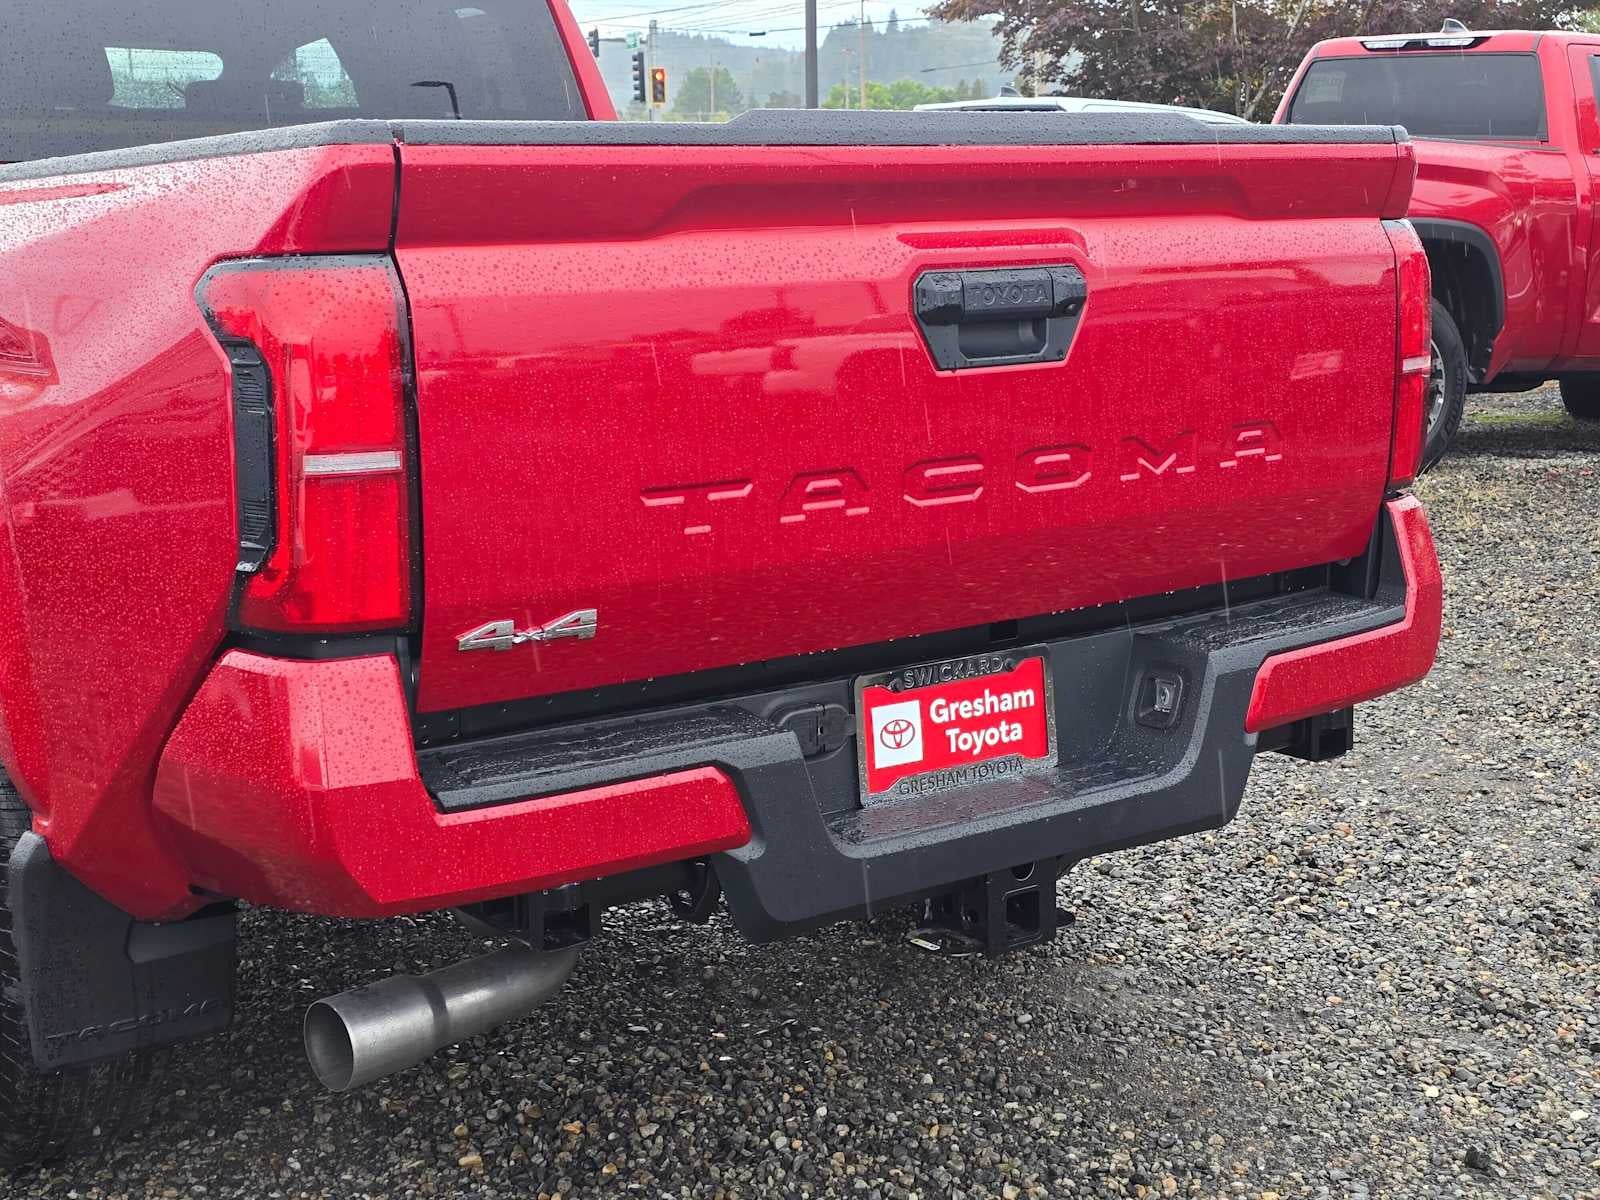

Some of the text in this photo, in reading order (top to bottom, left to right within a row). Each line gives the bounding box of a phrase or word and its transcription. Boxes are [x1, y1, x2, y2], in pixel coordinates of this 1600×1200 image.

[967, 284, 1049, 307] TOYOTA
[640, 420, 1283, 535] TACOMA
[903, 656, 1004, 688] SWICKARD
[930, 688, 1034, 724] Gresham
[945, 720, 1023, 755] Toyota
[900, 757, 1023, 796] GRESHAM TOYOTA
